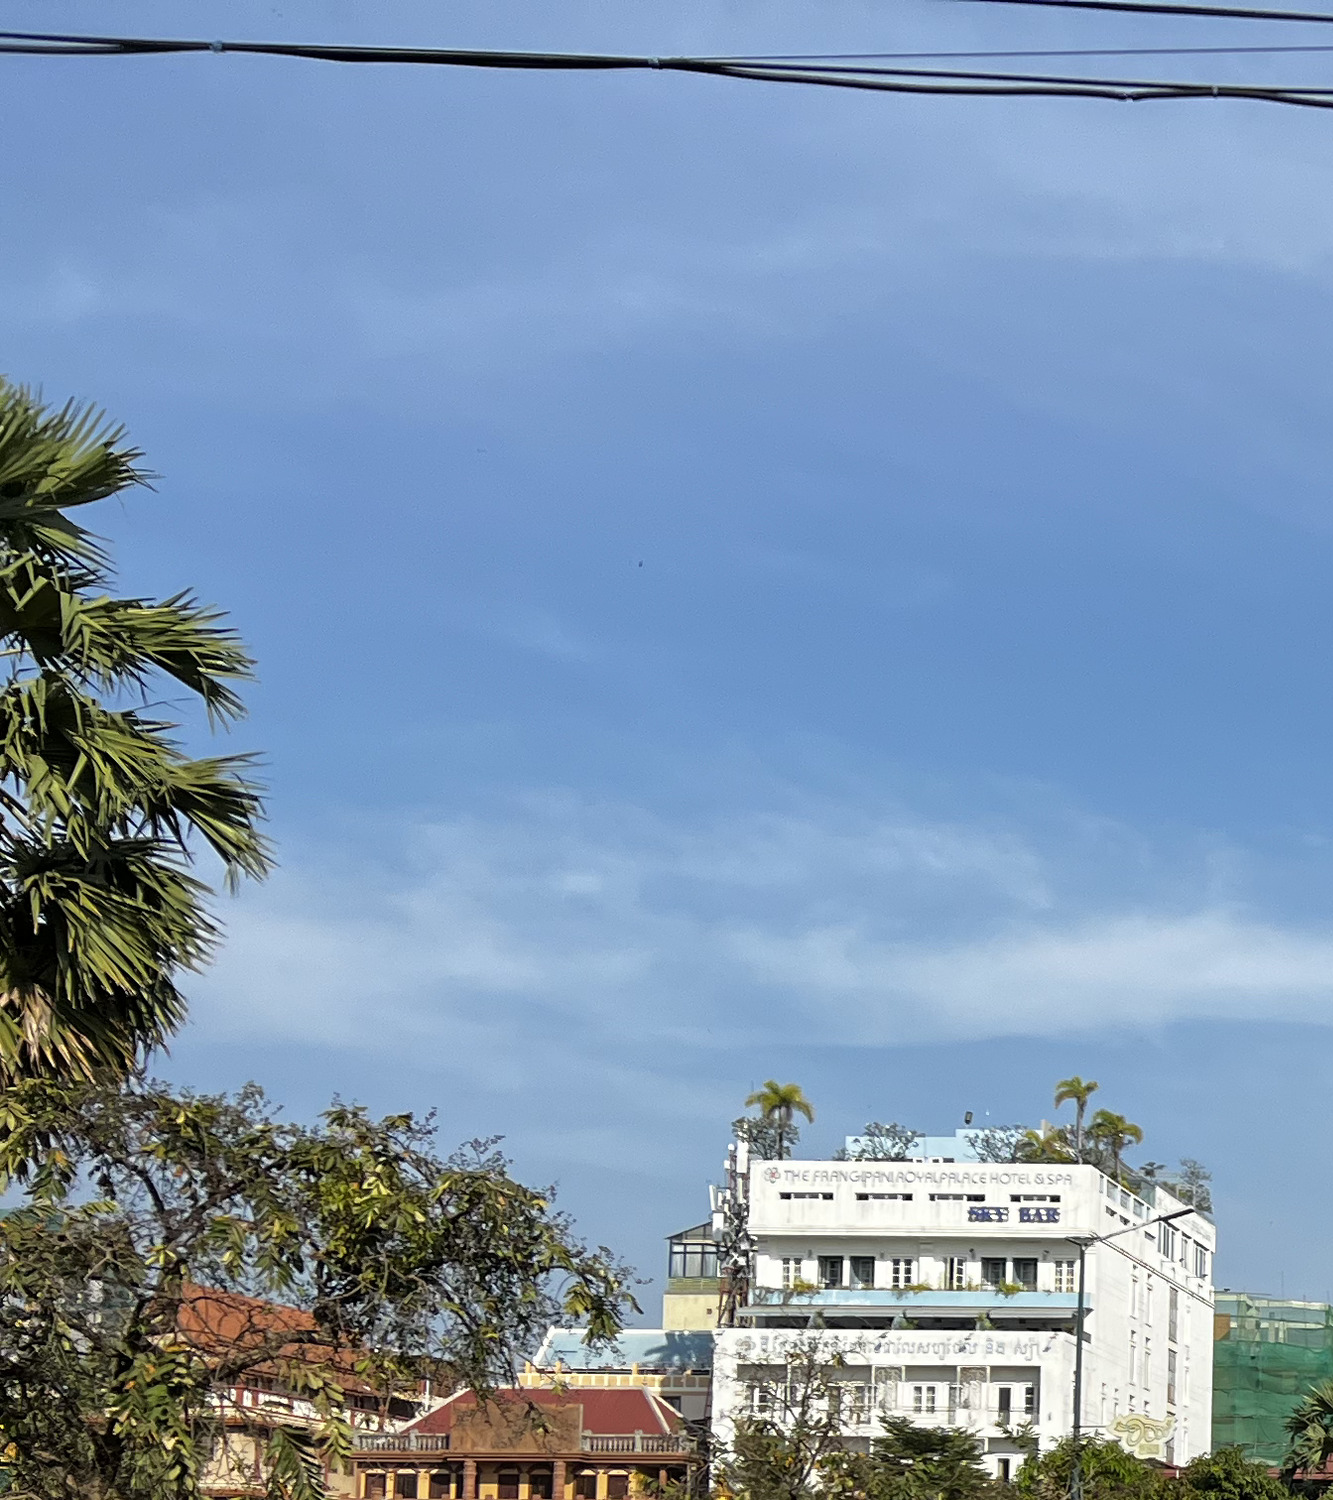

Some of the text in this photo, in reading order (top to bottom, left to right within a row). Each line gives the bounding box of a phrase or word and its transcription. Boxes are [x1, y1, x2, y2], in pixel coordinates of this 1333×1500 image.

[783, 1170, 810, 1183] THE
[813, 1170, 895, 1184] FRANGIPANI
[989, 1172, 1031, 1185] HOTEL
[1035, 1173, 1045, 1185] &
[1046, 1173, 1073, 1186] SPA
[1018, 1207, 1061, 1224] BAR
